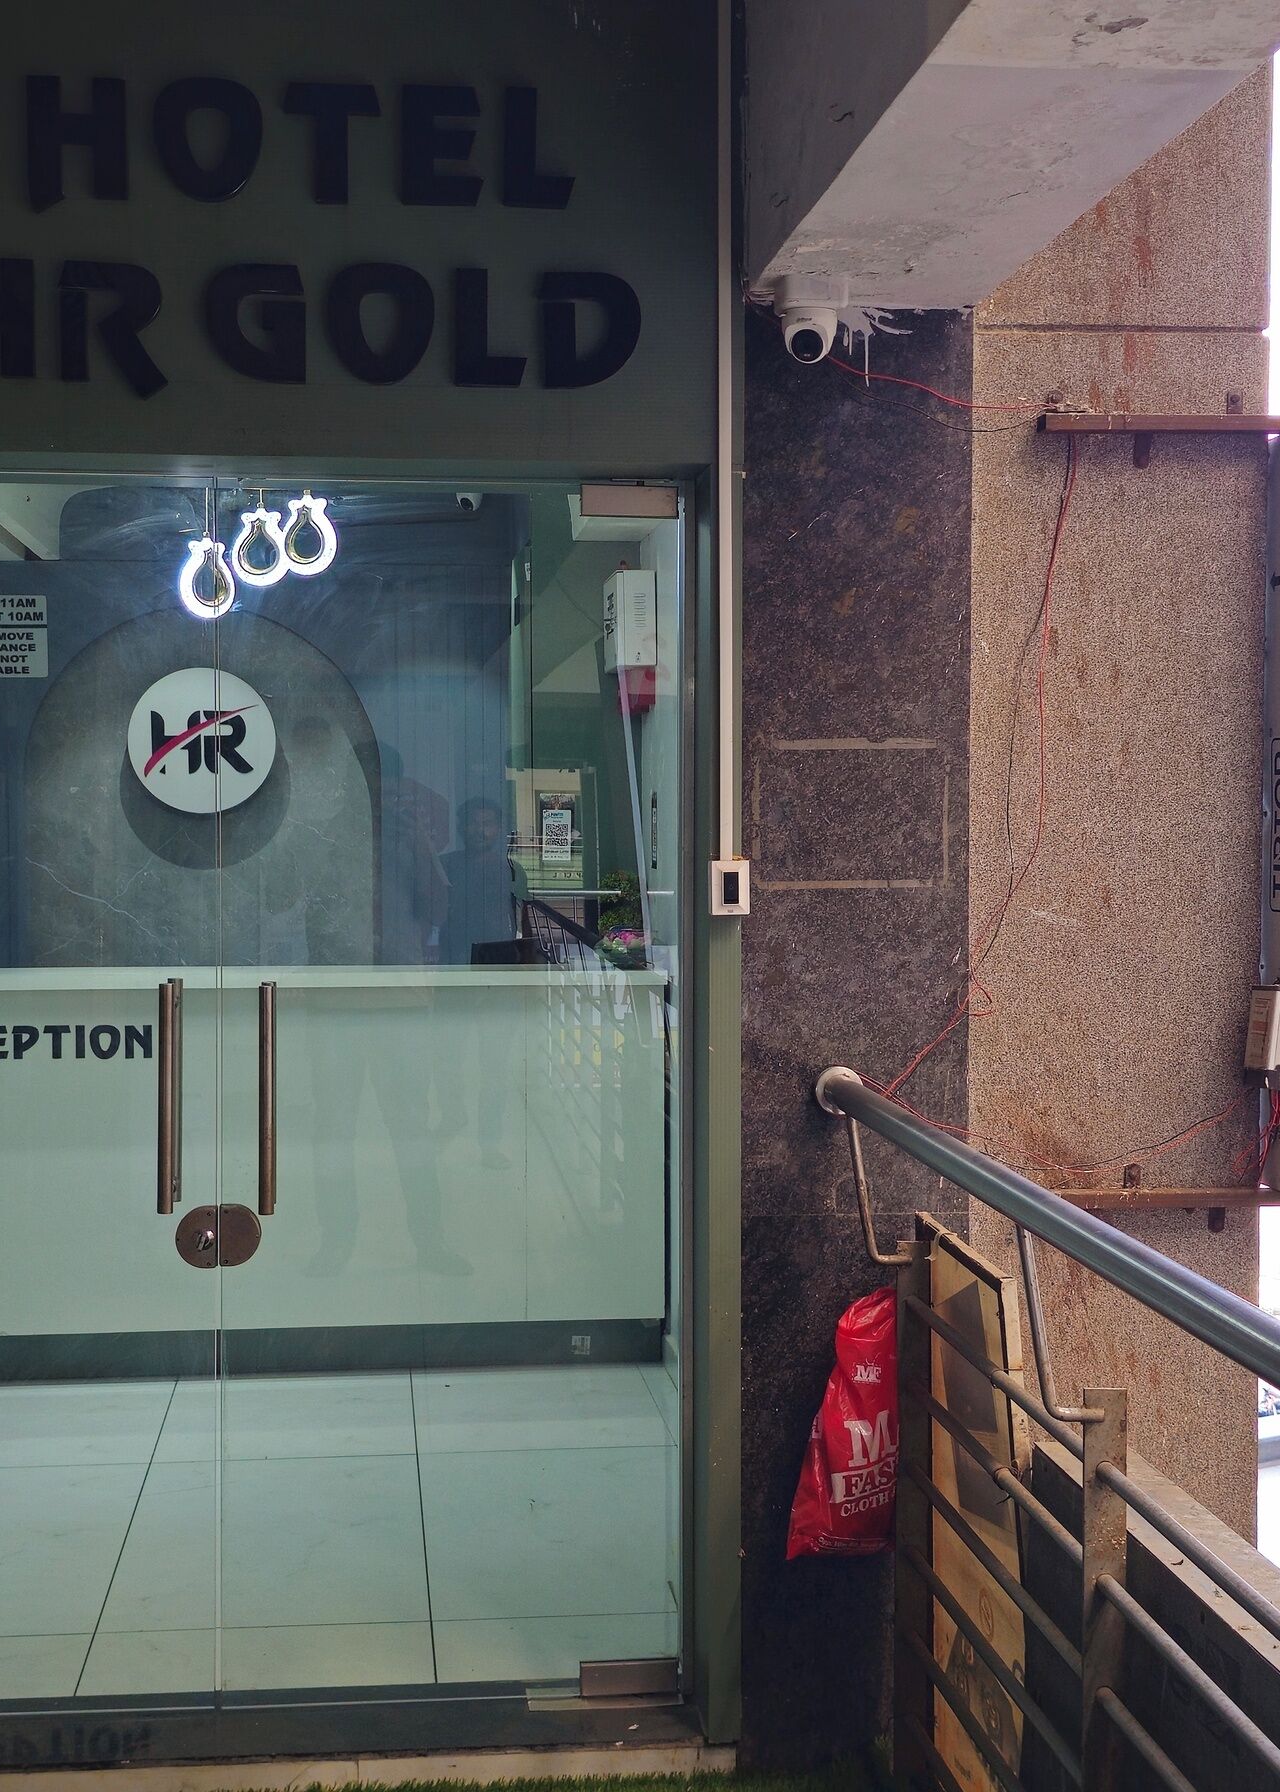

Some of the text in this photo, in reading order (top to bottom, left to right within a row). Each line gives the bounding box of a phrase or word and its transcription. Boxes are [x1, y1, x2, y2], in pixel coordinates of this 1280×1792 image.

[24, 75, 576, 213] HOTEL
[205, 262, 642, 389] GOLD
[1, 598, 37, 608] 11AM
[7, 611, 44, 622] 10AM
[0, 655, 29, 663] NOT
[150, 709, 255, 775] HR
